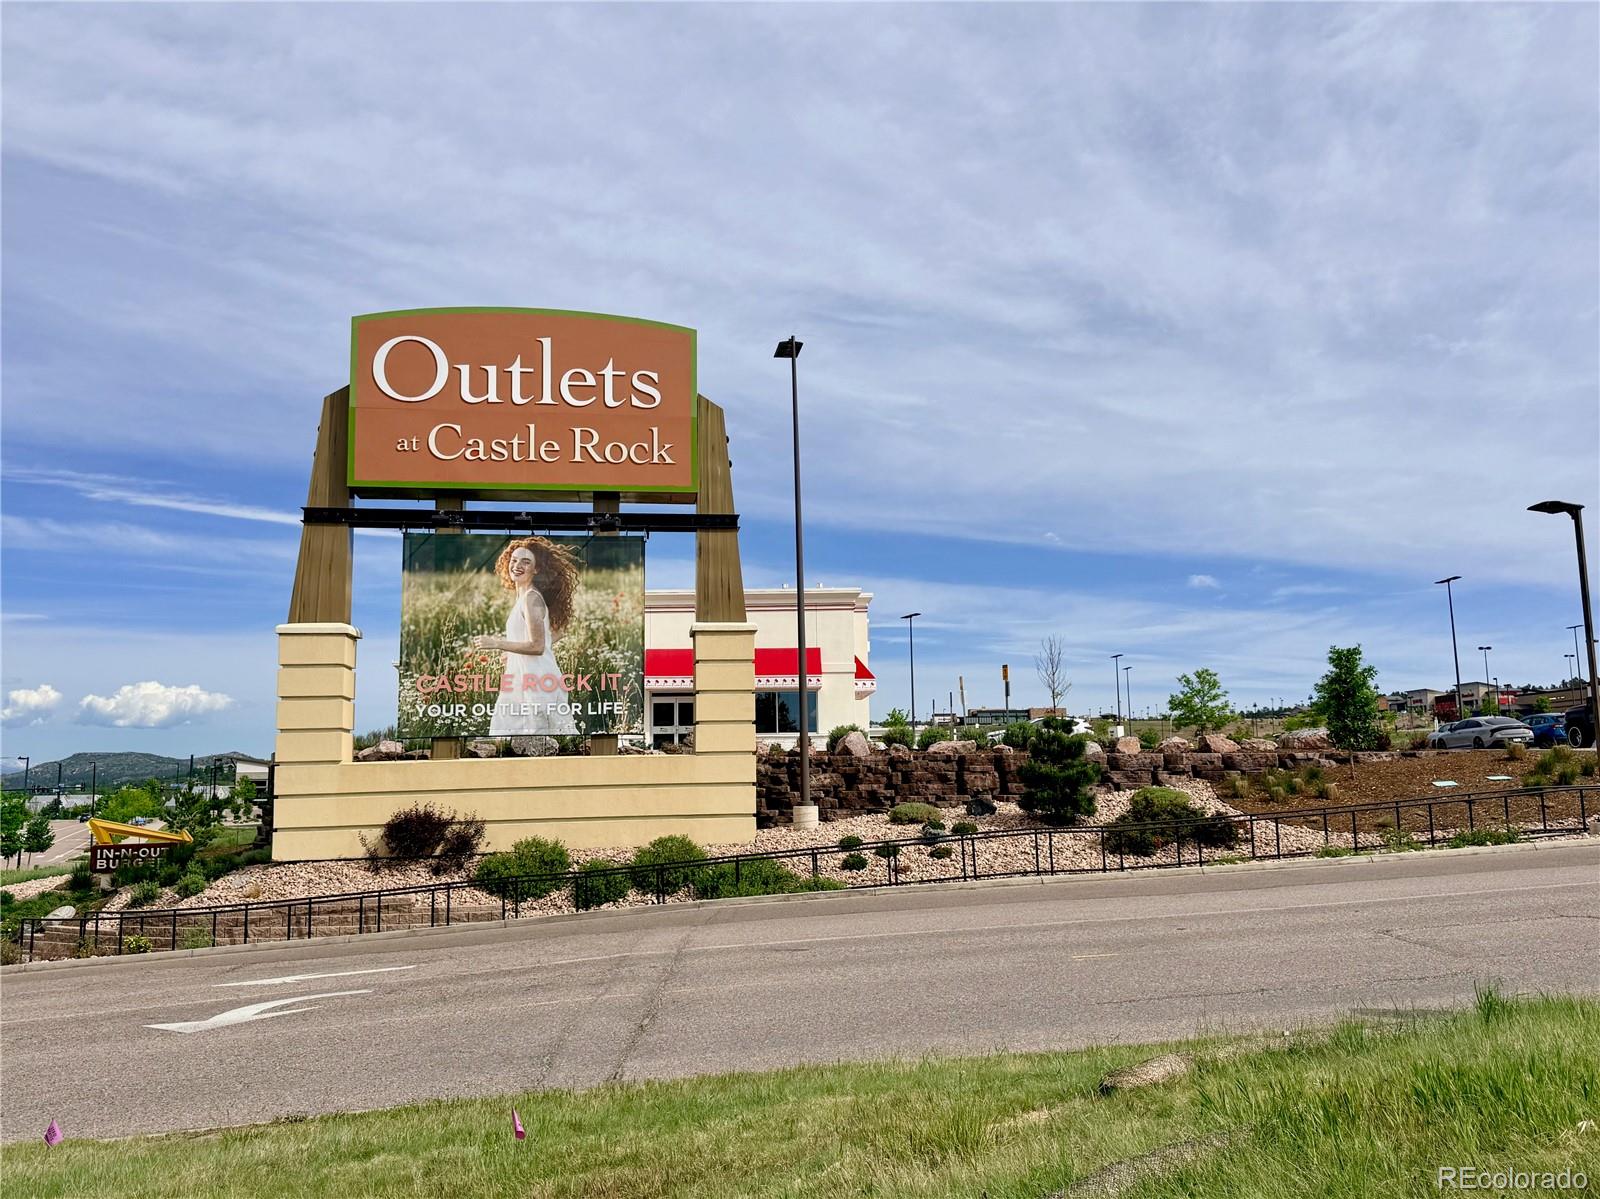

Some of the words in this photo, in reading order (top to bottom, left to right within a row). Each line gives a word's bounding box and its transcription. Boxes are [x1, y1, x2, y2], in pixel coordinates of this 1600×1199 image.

[371, 335, 662, 410] Outlets
[396, 435, 420, 452] at
[427, 423, 560, 462] Castle
[569, 426, 677, 465] Rock
[415, 673, 514, 693] CASTLE
[521, 673, 593, 692] ROCK
[415, 703, 467, 718] YOUR
[472, 703, 541, 717] OUTLET
[546, 702, 582, 716] FOR
[96, 847, 169, 859] IN-N-OUT
